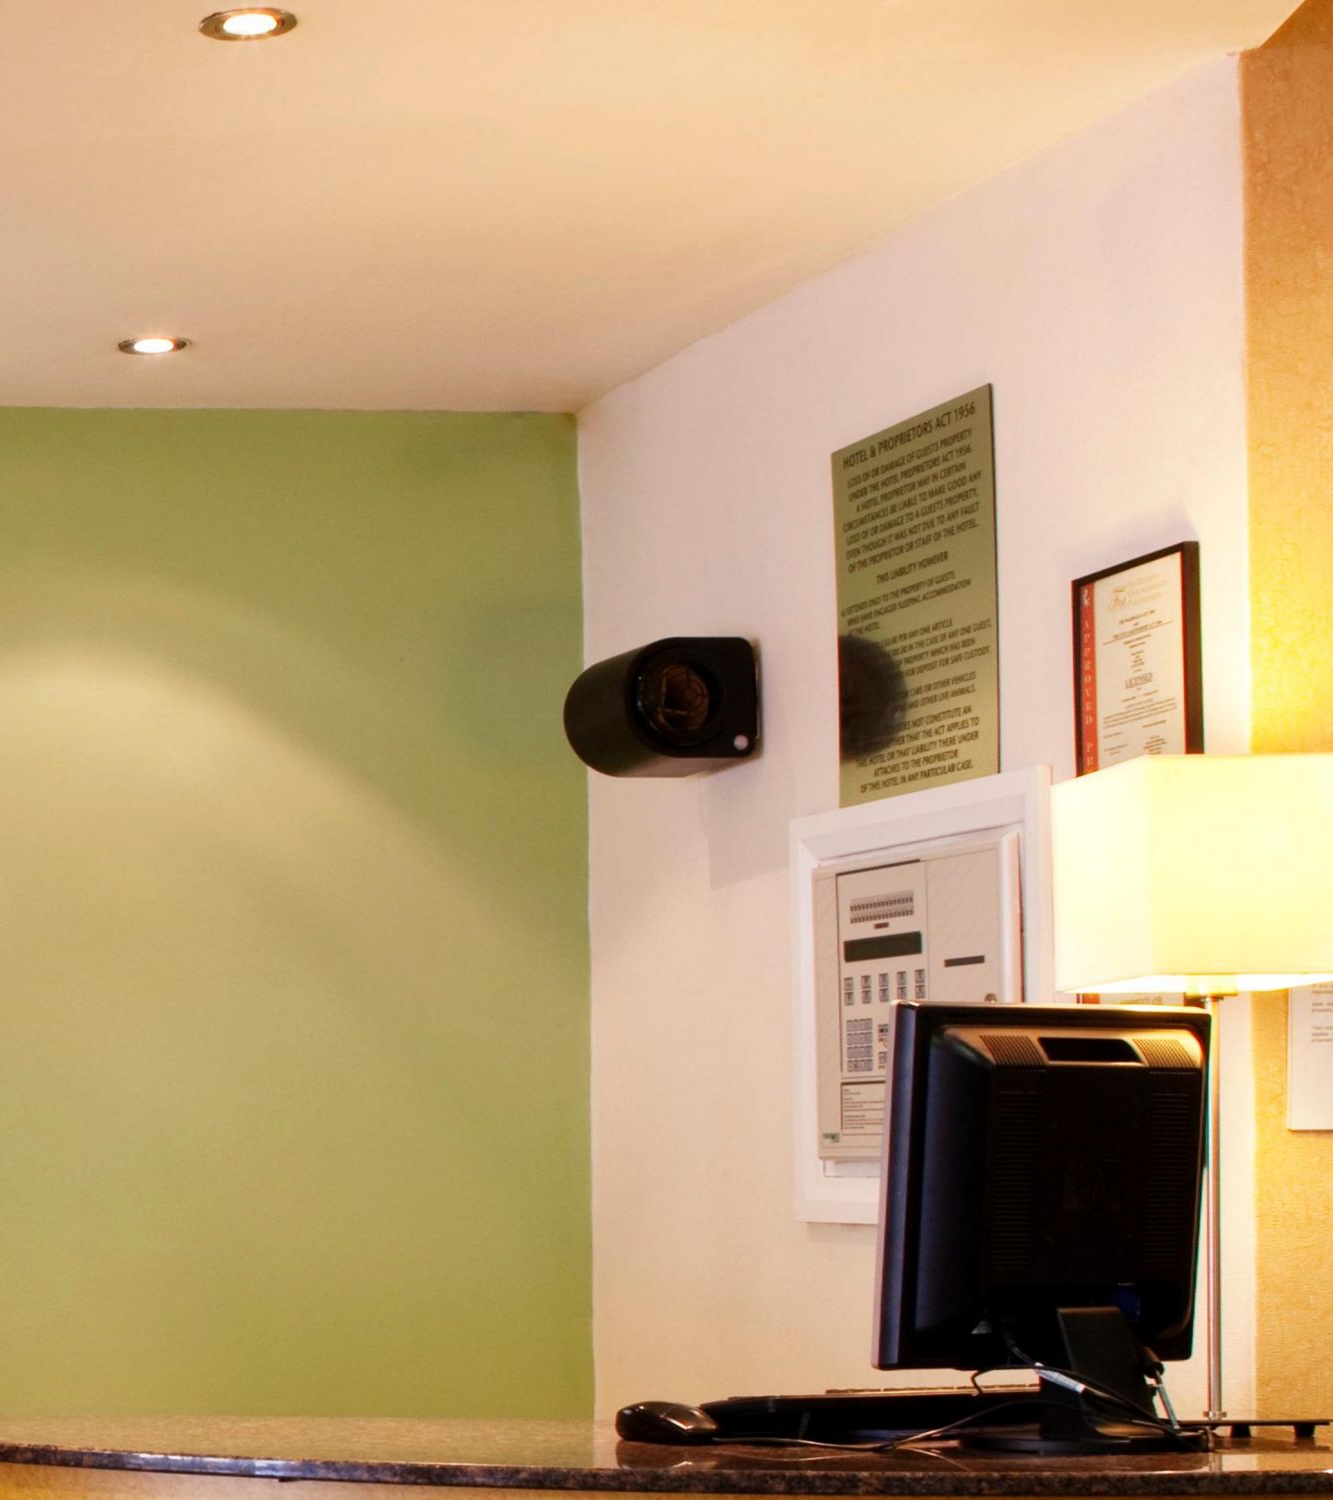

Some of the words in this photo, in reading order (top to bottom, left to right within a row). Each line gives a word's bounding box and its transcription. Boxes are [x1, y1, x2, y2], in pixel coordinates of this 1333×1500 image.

[843, 449, 868, 469] HOTEL
[870, 446, 876, 458] &
[878, 420, 932, 453] PROPRIETORS
[935, 411, 952, 430] ACT
[954, 401, 975, 421] 1956
